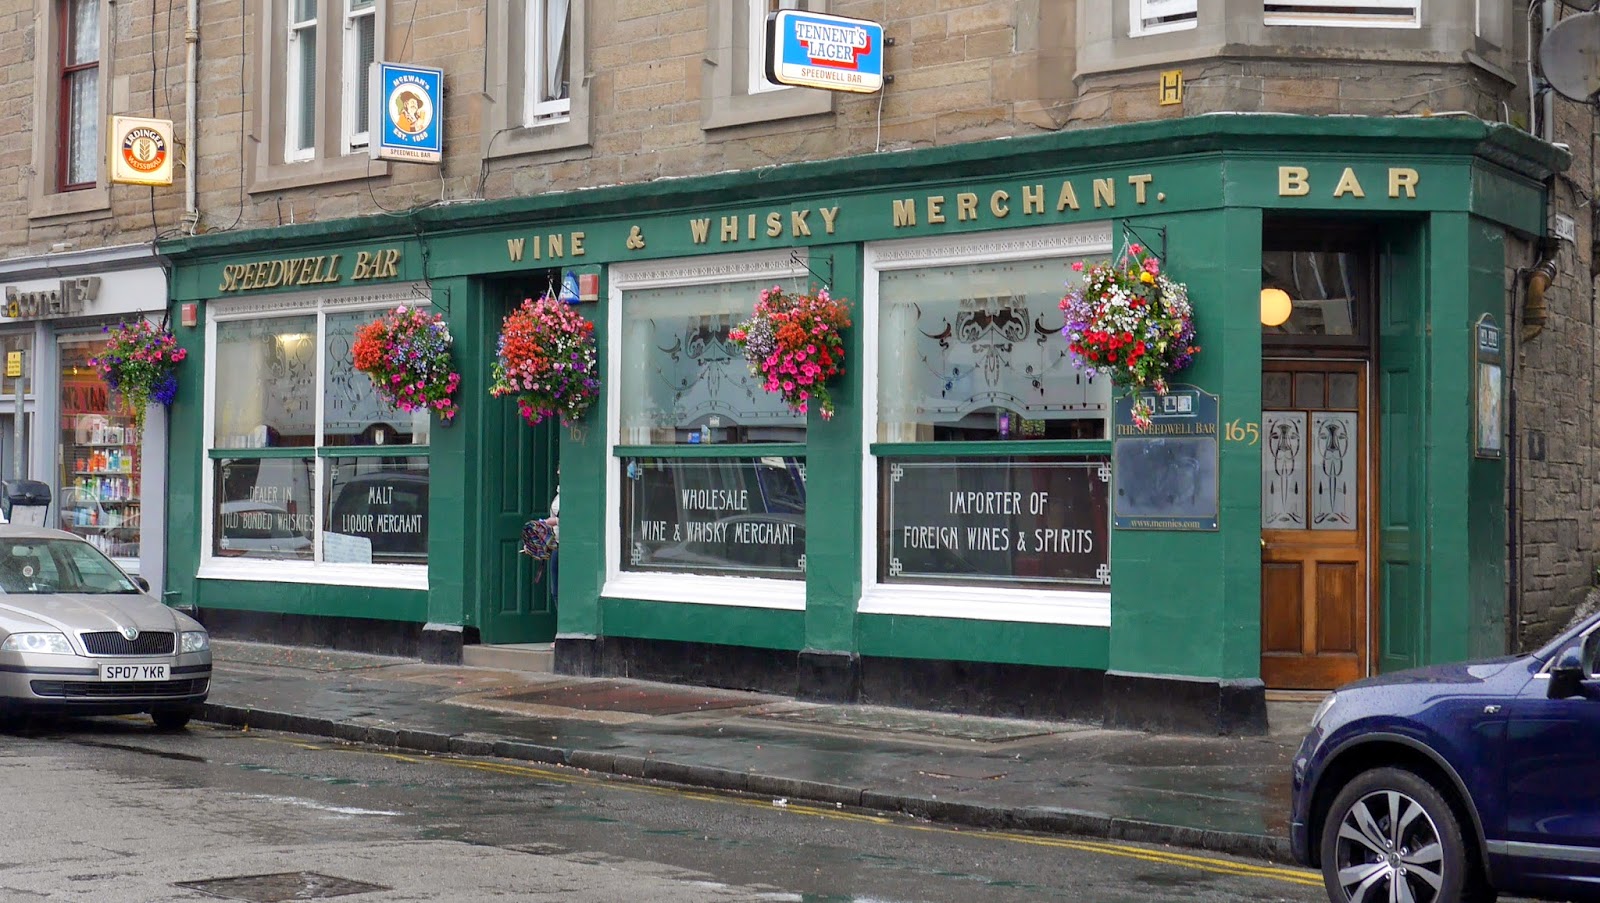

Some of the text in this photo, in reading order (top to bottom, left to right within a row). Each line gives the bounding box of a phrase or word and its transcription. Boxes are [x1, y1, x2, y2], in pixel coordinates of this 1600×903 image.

[797, 23, 865, 46] TENNENT'S
[809, 41, 852, 61] LAGER
[801, 67, 862, 83] SPEEDWELL BAR
[1163, 74, 1179, 101] H
[125, 130, 164, 148] ERDINGER
[393, 129, 408, 142] EST.
[390, 149, 420, 158] SPEEDWELL
[1279, 166, 1419, 198] BAR
[507, 174, 1166, 262] WINE & WHISKY MERCHANT.
[218, 249, 400, 292] SPEEDWELL BAR
[1116, 423, 1215, 435] THE SPEEDWELL BAR
[1225, 420, 1259, 446] 165
[249, 486, 292, 504] DEALER IN
[368, 486, 393, 505] MALT
[682, 489, 748, 511] WHOLESALE
[949, 491, 1048, 515] IMPORTER OF
[225, 512, 315, 532] OLD BONDED WHISKIES
[342, 514, 422, 534] LIQUOR MERCHANT
[641, 520, 796, 545] WINE & WHISKY MERCHANT
[904, 526, 1093, 554] FOREIGN WINES & SPIRITS
[106, 666, 164, 679] SP07 YKR
